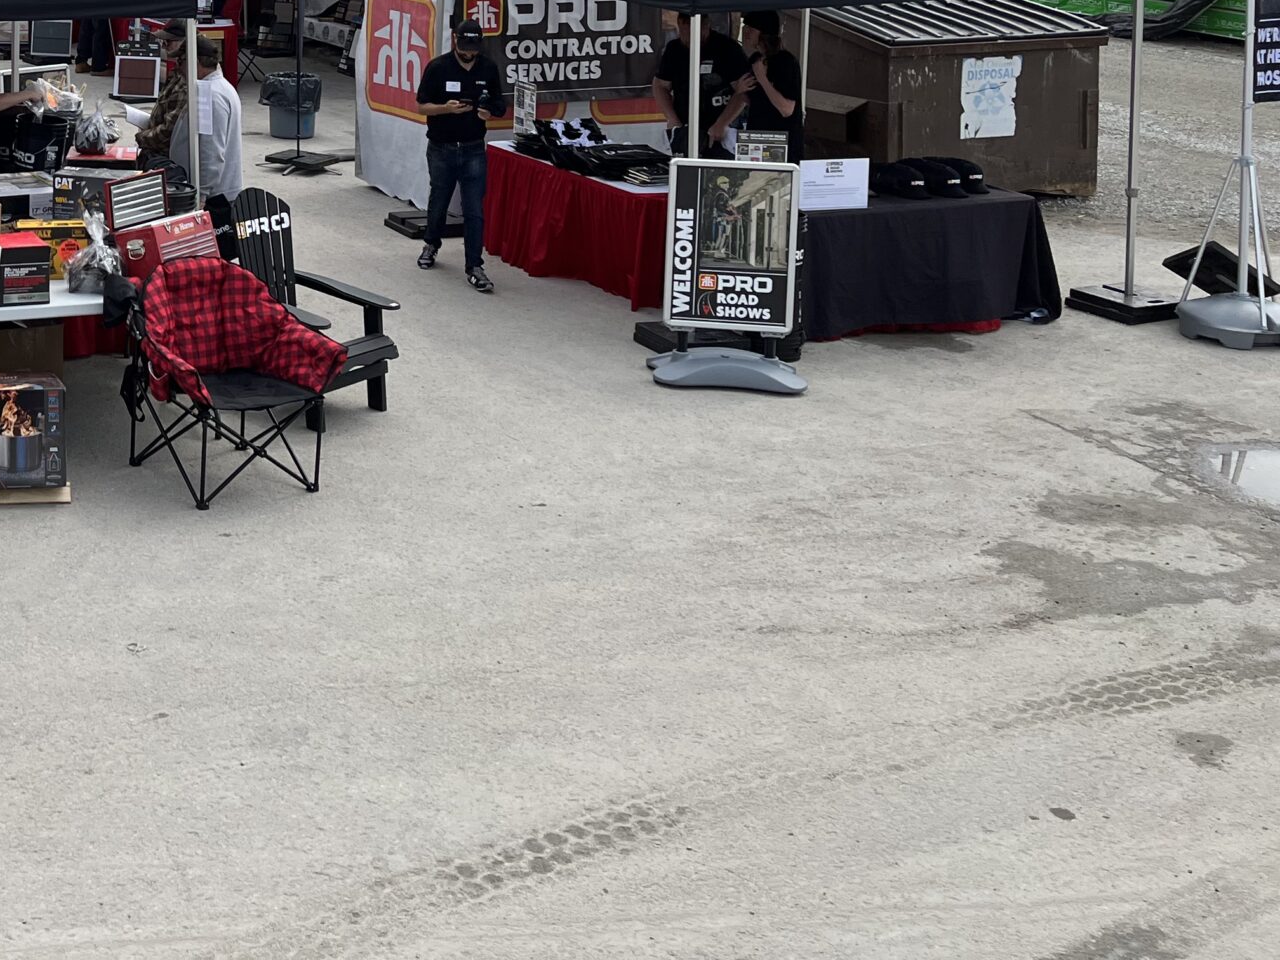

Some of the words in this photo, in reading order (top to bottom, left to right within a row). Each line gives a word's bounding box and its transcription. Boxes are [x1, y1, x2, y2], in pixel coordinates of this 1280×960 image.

[505, 35, 654, 60] CONTRACTOR
[506, 60, 602, 84] SERVICES
[967, 68, 1016, 81] DISPOSAL
[54, 177, 73, 190] CAT
[246, 212, 290, 238] PRO
[672, 208, 695, 314] WELCOME
[717, 275, 773, 293] PRO
[716, 292, 759, 306] ROAD
[716, 306, 771, 320] SHOWS
